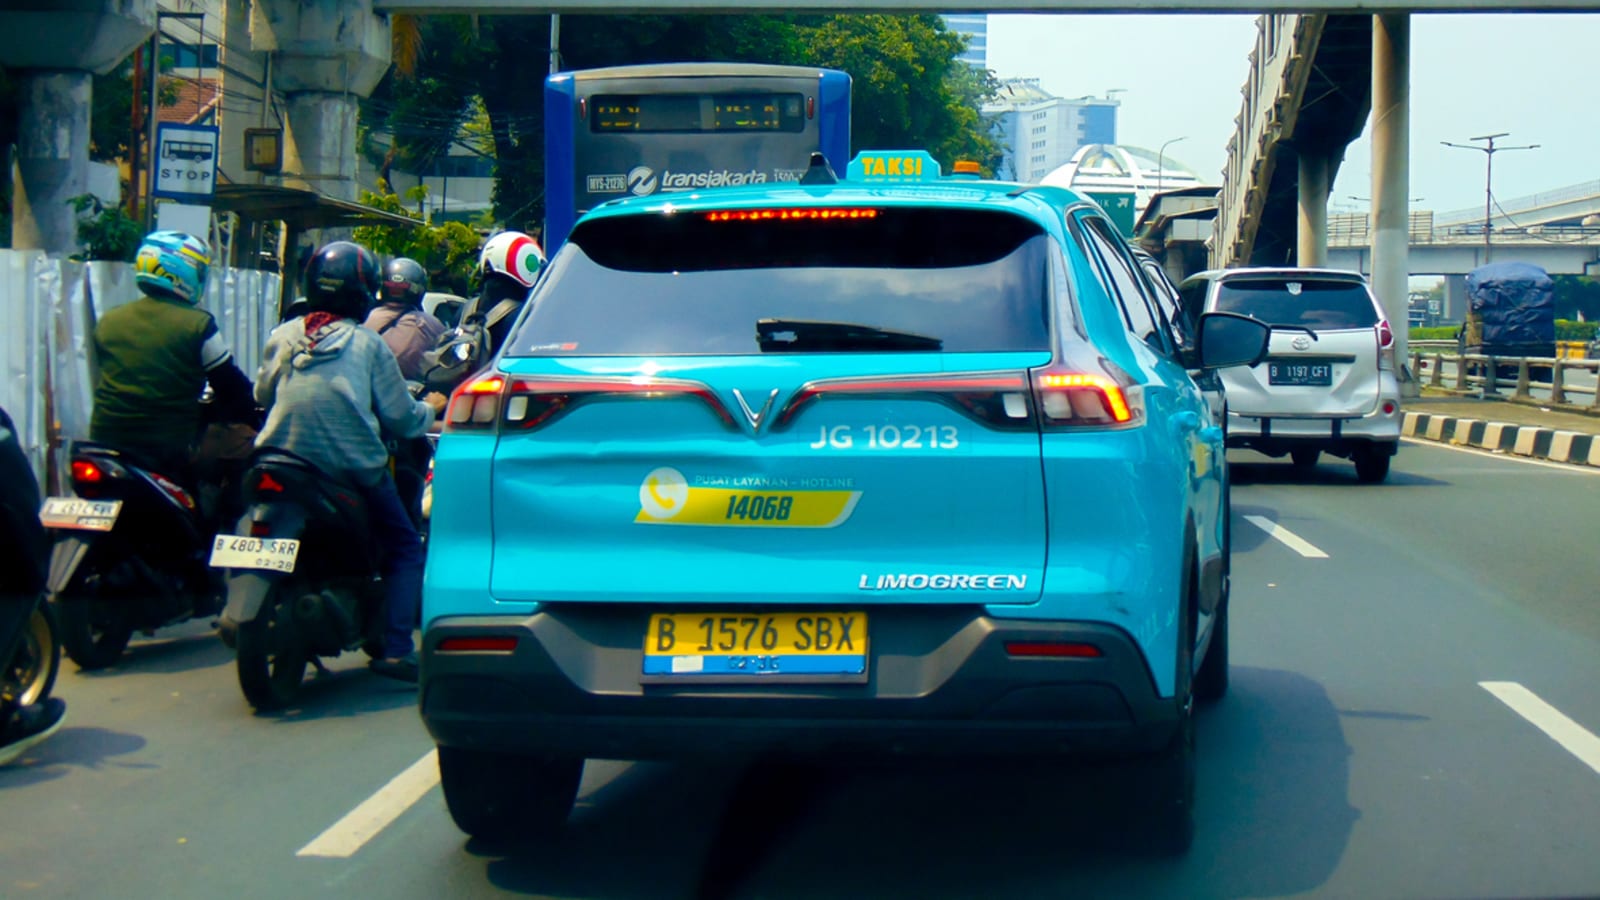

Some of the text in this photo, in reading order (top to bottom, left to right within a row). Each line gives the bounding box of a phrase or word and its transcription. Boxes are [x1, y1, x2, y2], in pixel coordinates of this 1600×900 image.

[161, 168, 210, 181] STOP
[862, 157, 922, 175] TAKSI
[662, 170, 767, 188] transjakarta
[1271, 366, 1278, 377] B
[1287, 366, 1308, 377] 1197
[810, 426, 959, 449] JG 10213
[695, 475, 730, 485] PUSAT
[733, 476, 788, 487] LAYANAN
[802, 478, 854, 488] HOTLINE
[725, 495, 793, 521] 14068
[216, 538, 296, 555] B 4803 SRR
[256, 558, 293, 570] 02-28
[858, 573, 1027, 592] LIMOGREEN
[656, 616, 855, 652] B 1576 SBX
